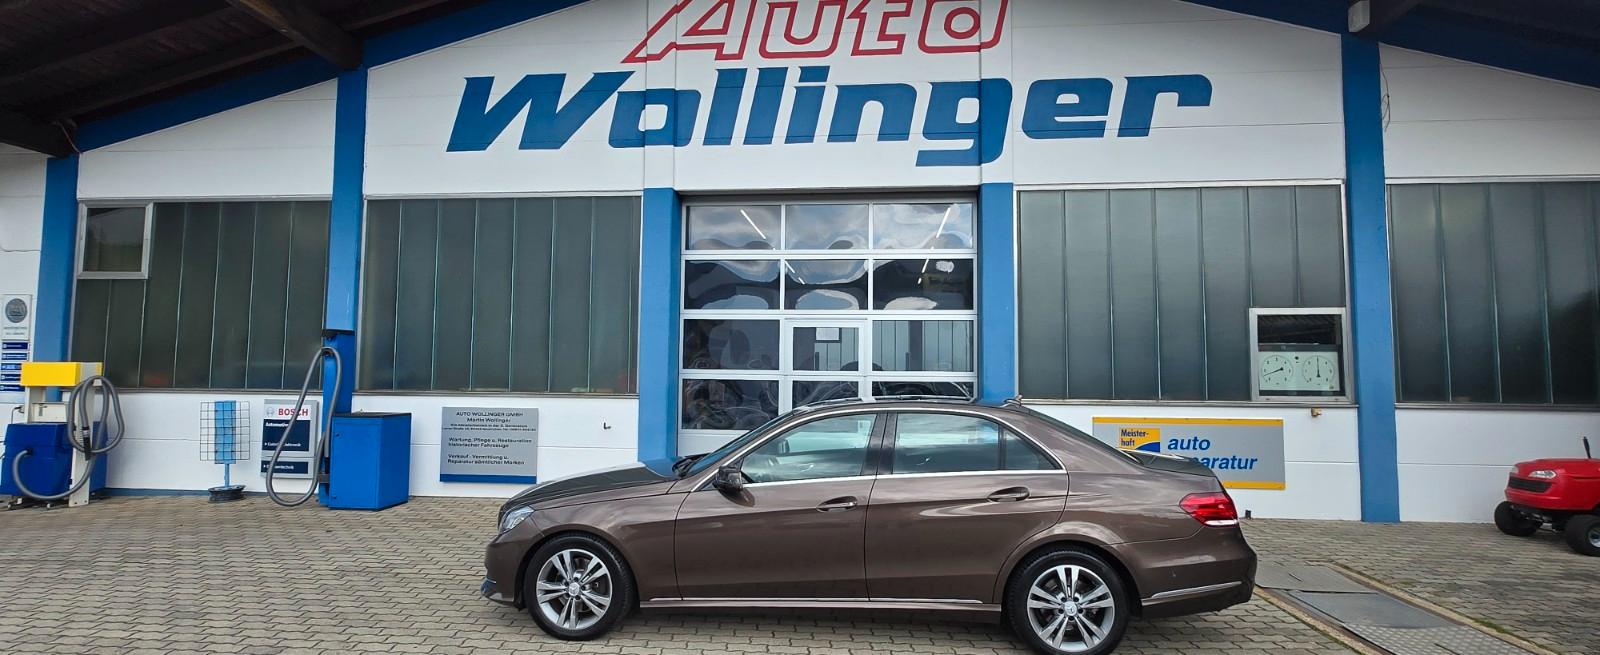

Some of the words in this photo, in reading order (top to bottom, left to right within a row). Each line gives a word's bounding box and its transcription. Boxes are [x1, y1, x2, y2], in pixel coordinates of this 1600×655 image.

[621, 0, 1007, 63] Auto
[446, 65, 1212, 167] Wollinger
[278, 408, 308, 416] BOSH
[1120, 429, 1149, 437] Meister-
[1120, 438, 1135, 447] haft
[1168, 436, 1211, 450] auto
[1192, 456, 1258, 470] aratur
